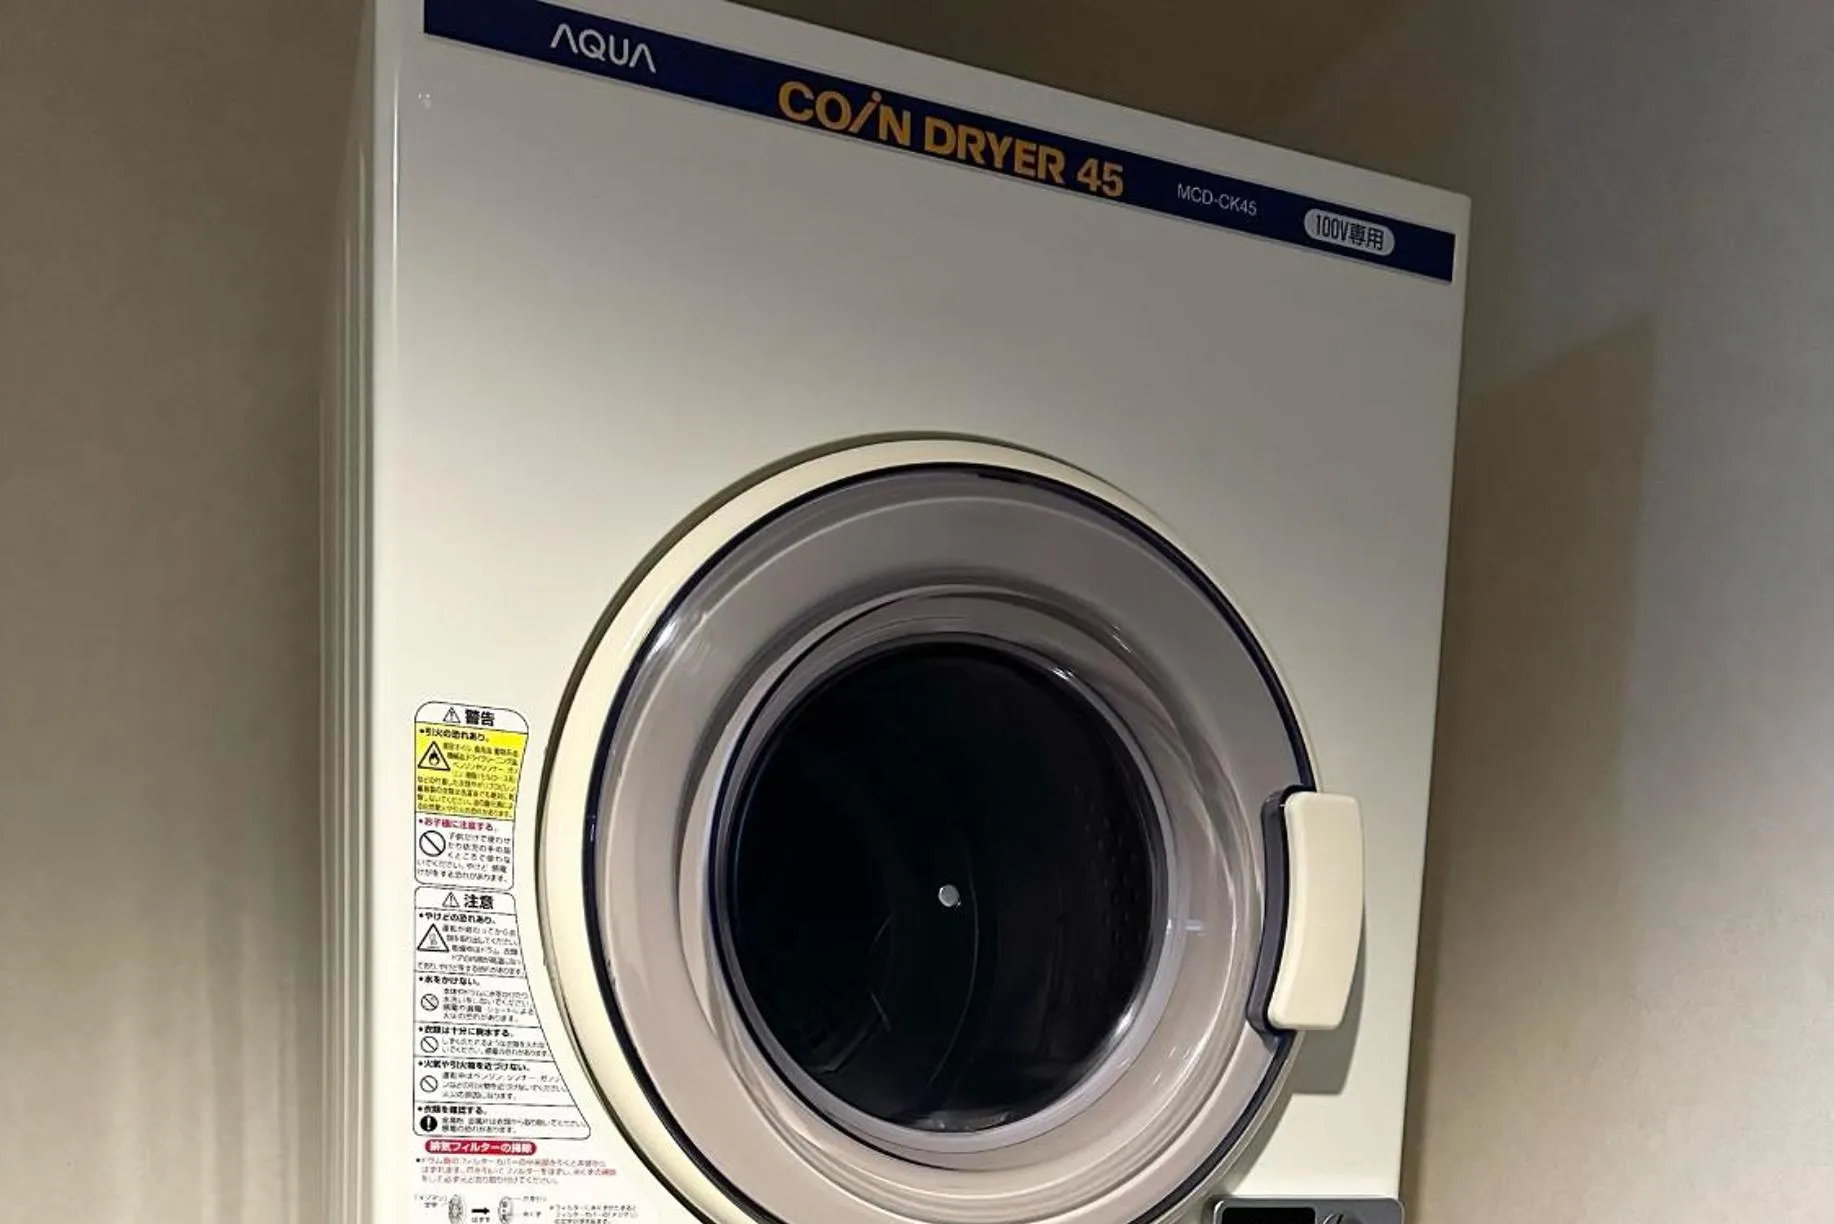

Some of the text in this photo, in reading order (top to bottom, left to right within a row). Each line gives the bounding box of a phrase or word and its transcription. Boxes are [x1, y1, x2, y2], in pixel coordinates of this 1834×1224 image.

[549, 23, 657, 74] AQUA
[924, 115, 1065, 185] DRYER
[1075, 156, 1125, 198] 45
[1176, 182, 1259, 218] MCD-CK45
[1314, 213, 1386, 252] 100V専用
[464, 708, 496, 727] 警告
[463, 893, 495, 910] 注意
